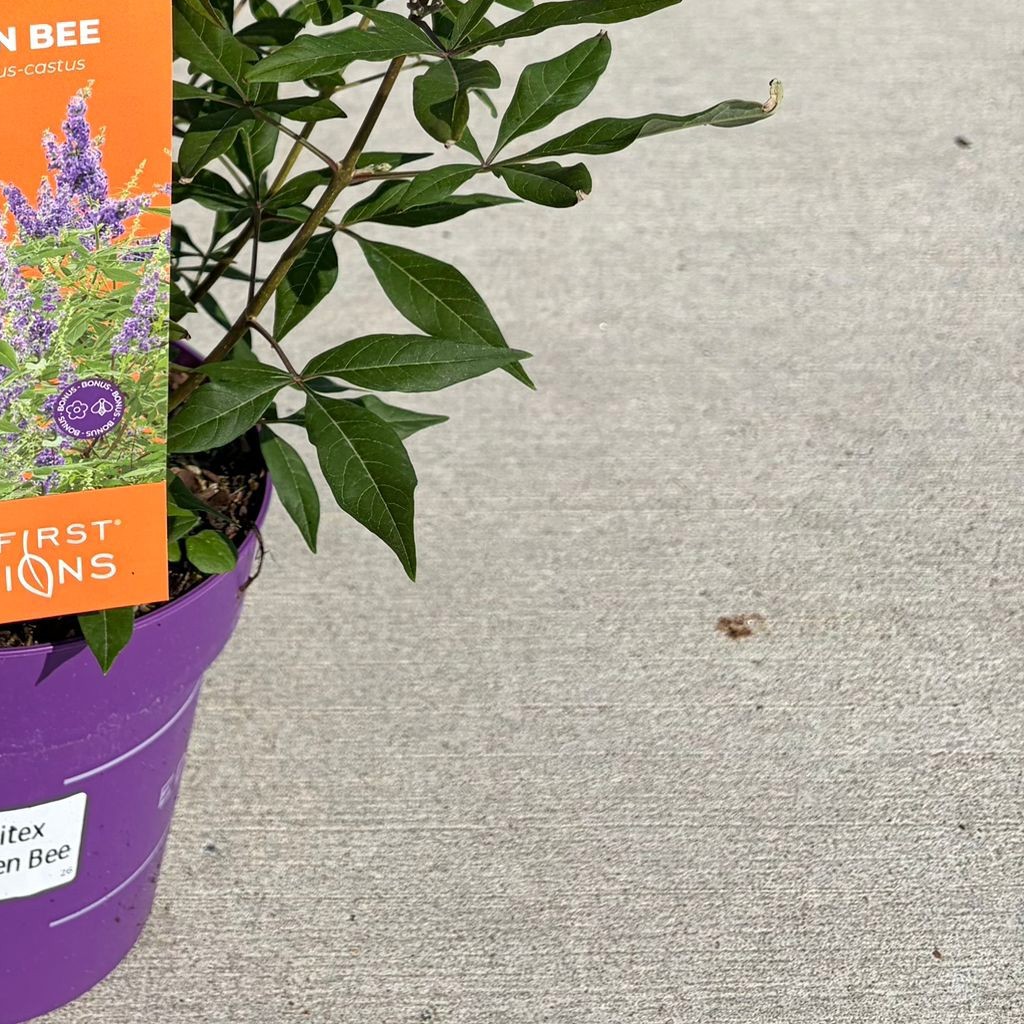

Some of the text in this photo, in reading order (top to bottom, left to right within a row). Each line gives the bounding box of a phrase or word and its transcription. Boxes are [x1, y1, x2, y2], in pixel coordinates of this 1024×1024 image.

[29, 18, 101, 50] BEE
[57, 380, 123, 437] BONUS BONUS BONUS BONUS BONUS
[28, 844, 71, 869] Bee
